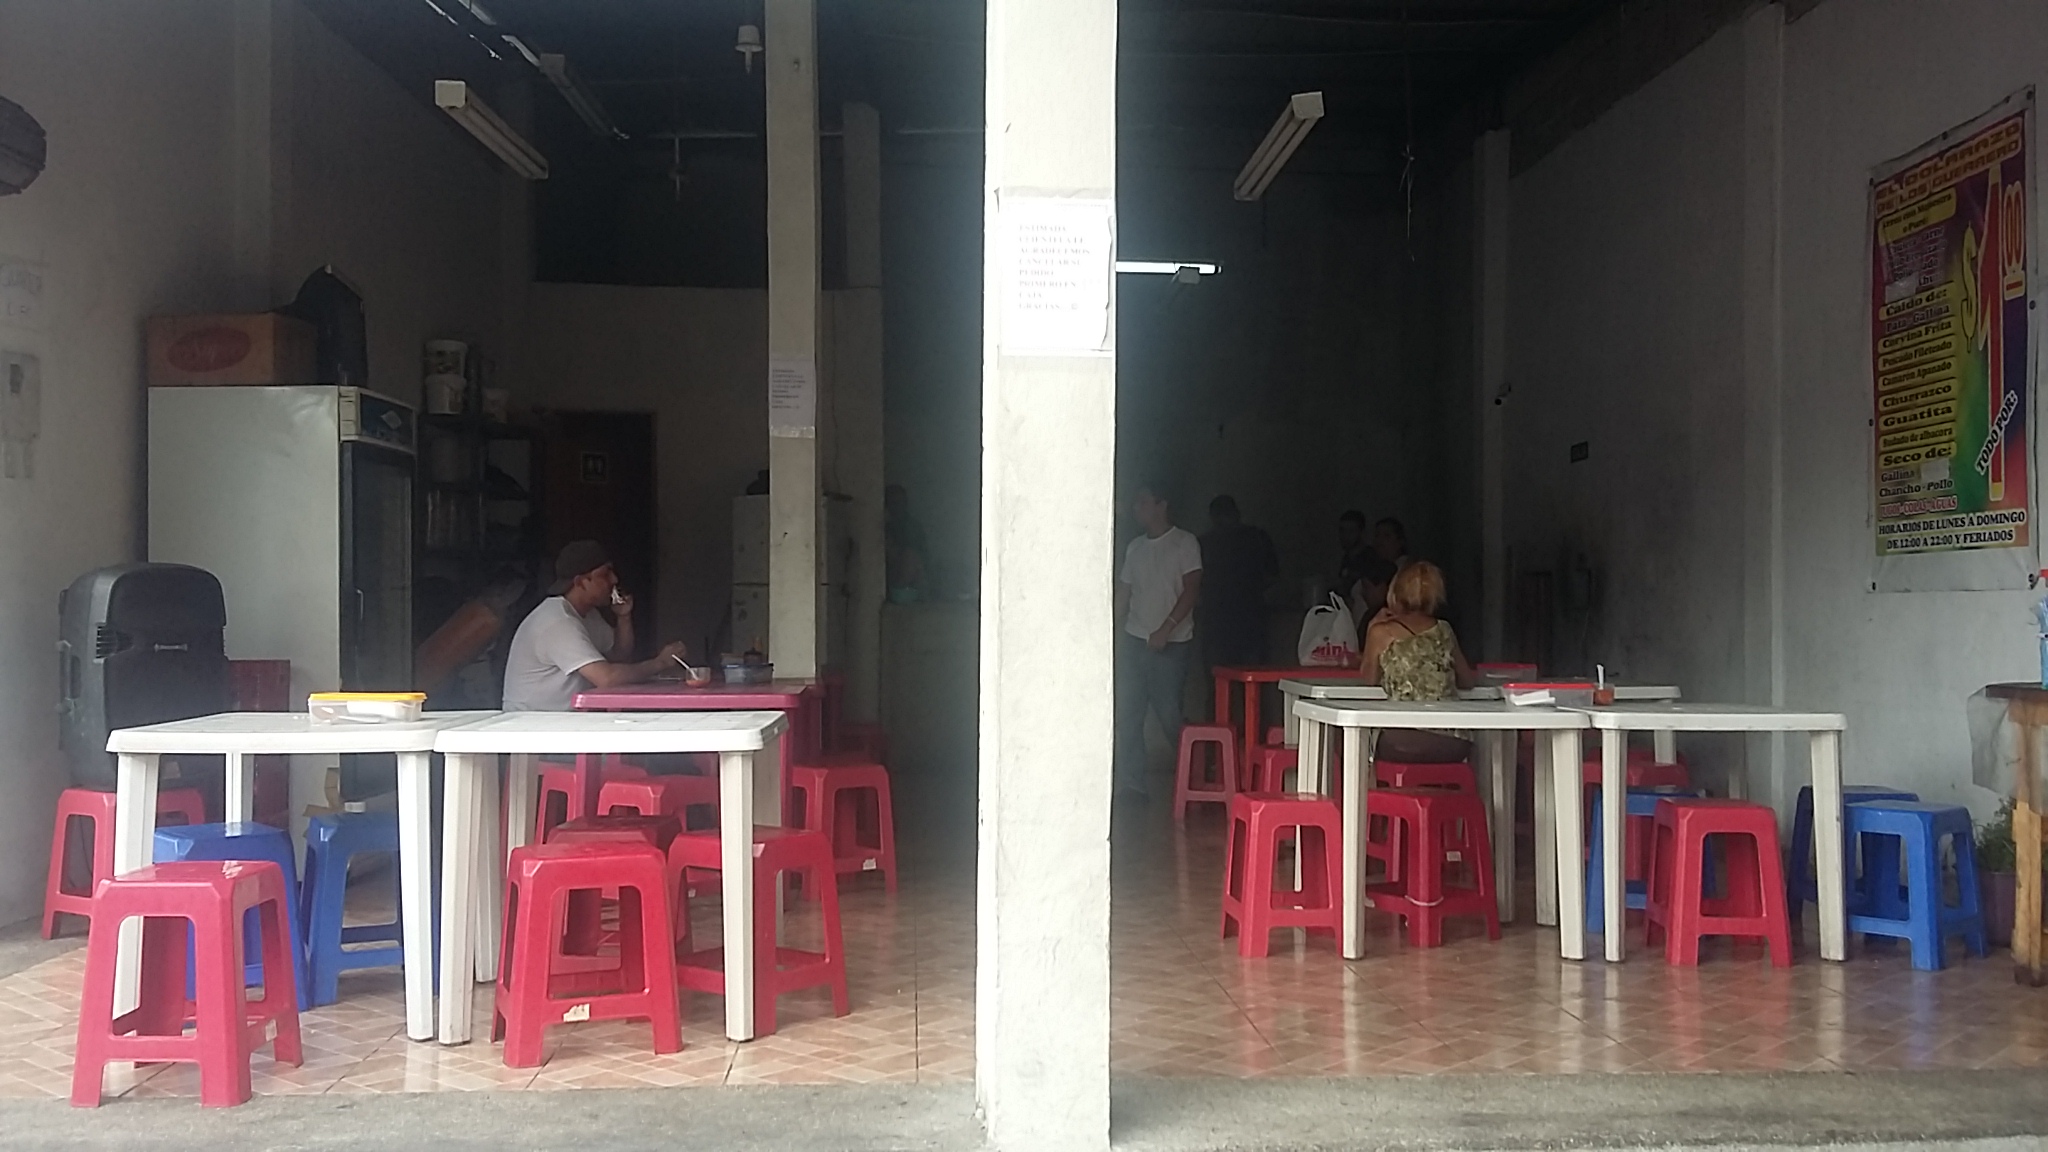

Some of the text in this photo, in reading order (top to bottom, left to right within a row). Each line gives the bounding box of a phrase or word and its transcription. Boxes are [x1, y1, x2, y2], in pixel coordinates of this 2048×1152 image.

[1886, 297, 1923, 317] Caldo
[1924, 320, 1952, 336] Frita
[1883, 405, 1953, 427] Guatita
[1975, 391, 2018, 473] TODO POR:
[1883, 446, 1952, 467] Seco de:
[1879, 484, 1922, 498] Chancho
[1926, 478, 1954, 491] Pollo
[1878, 522, 1922, 535] HORARIOS
[1936, 516, 1966, 530] LUNES
[1976, 511, 2026, 526] DOMINGO
[1930, 533, 1953, 546] 22:00
[1963, 529, 2014, 543] FERIADOS
